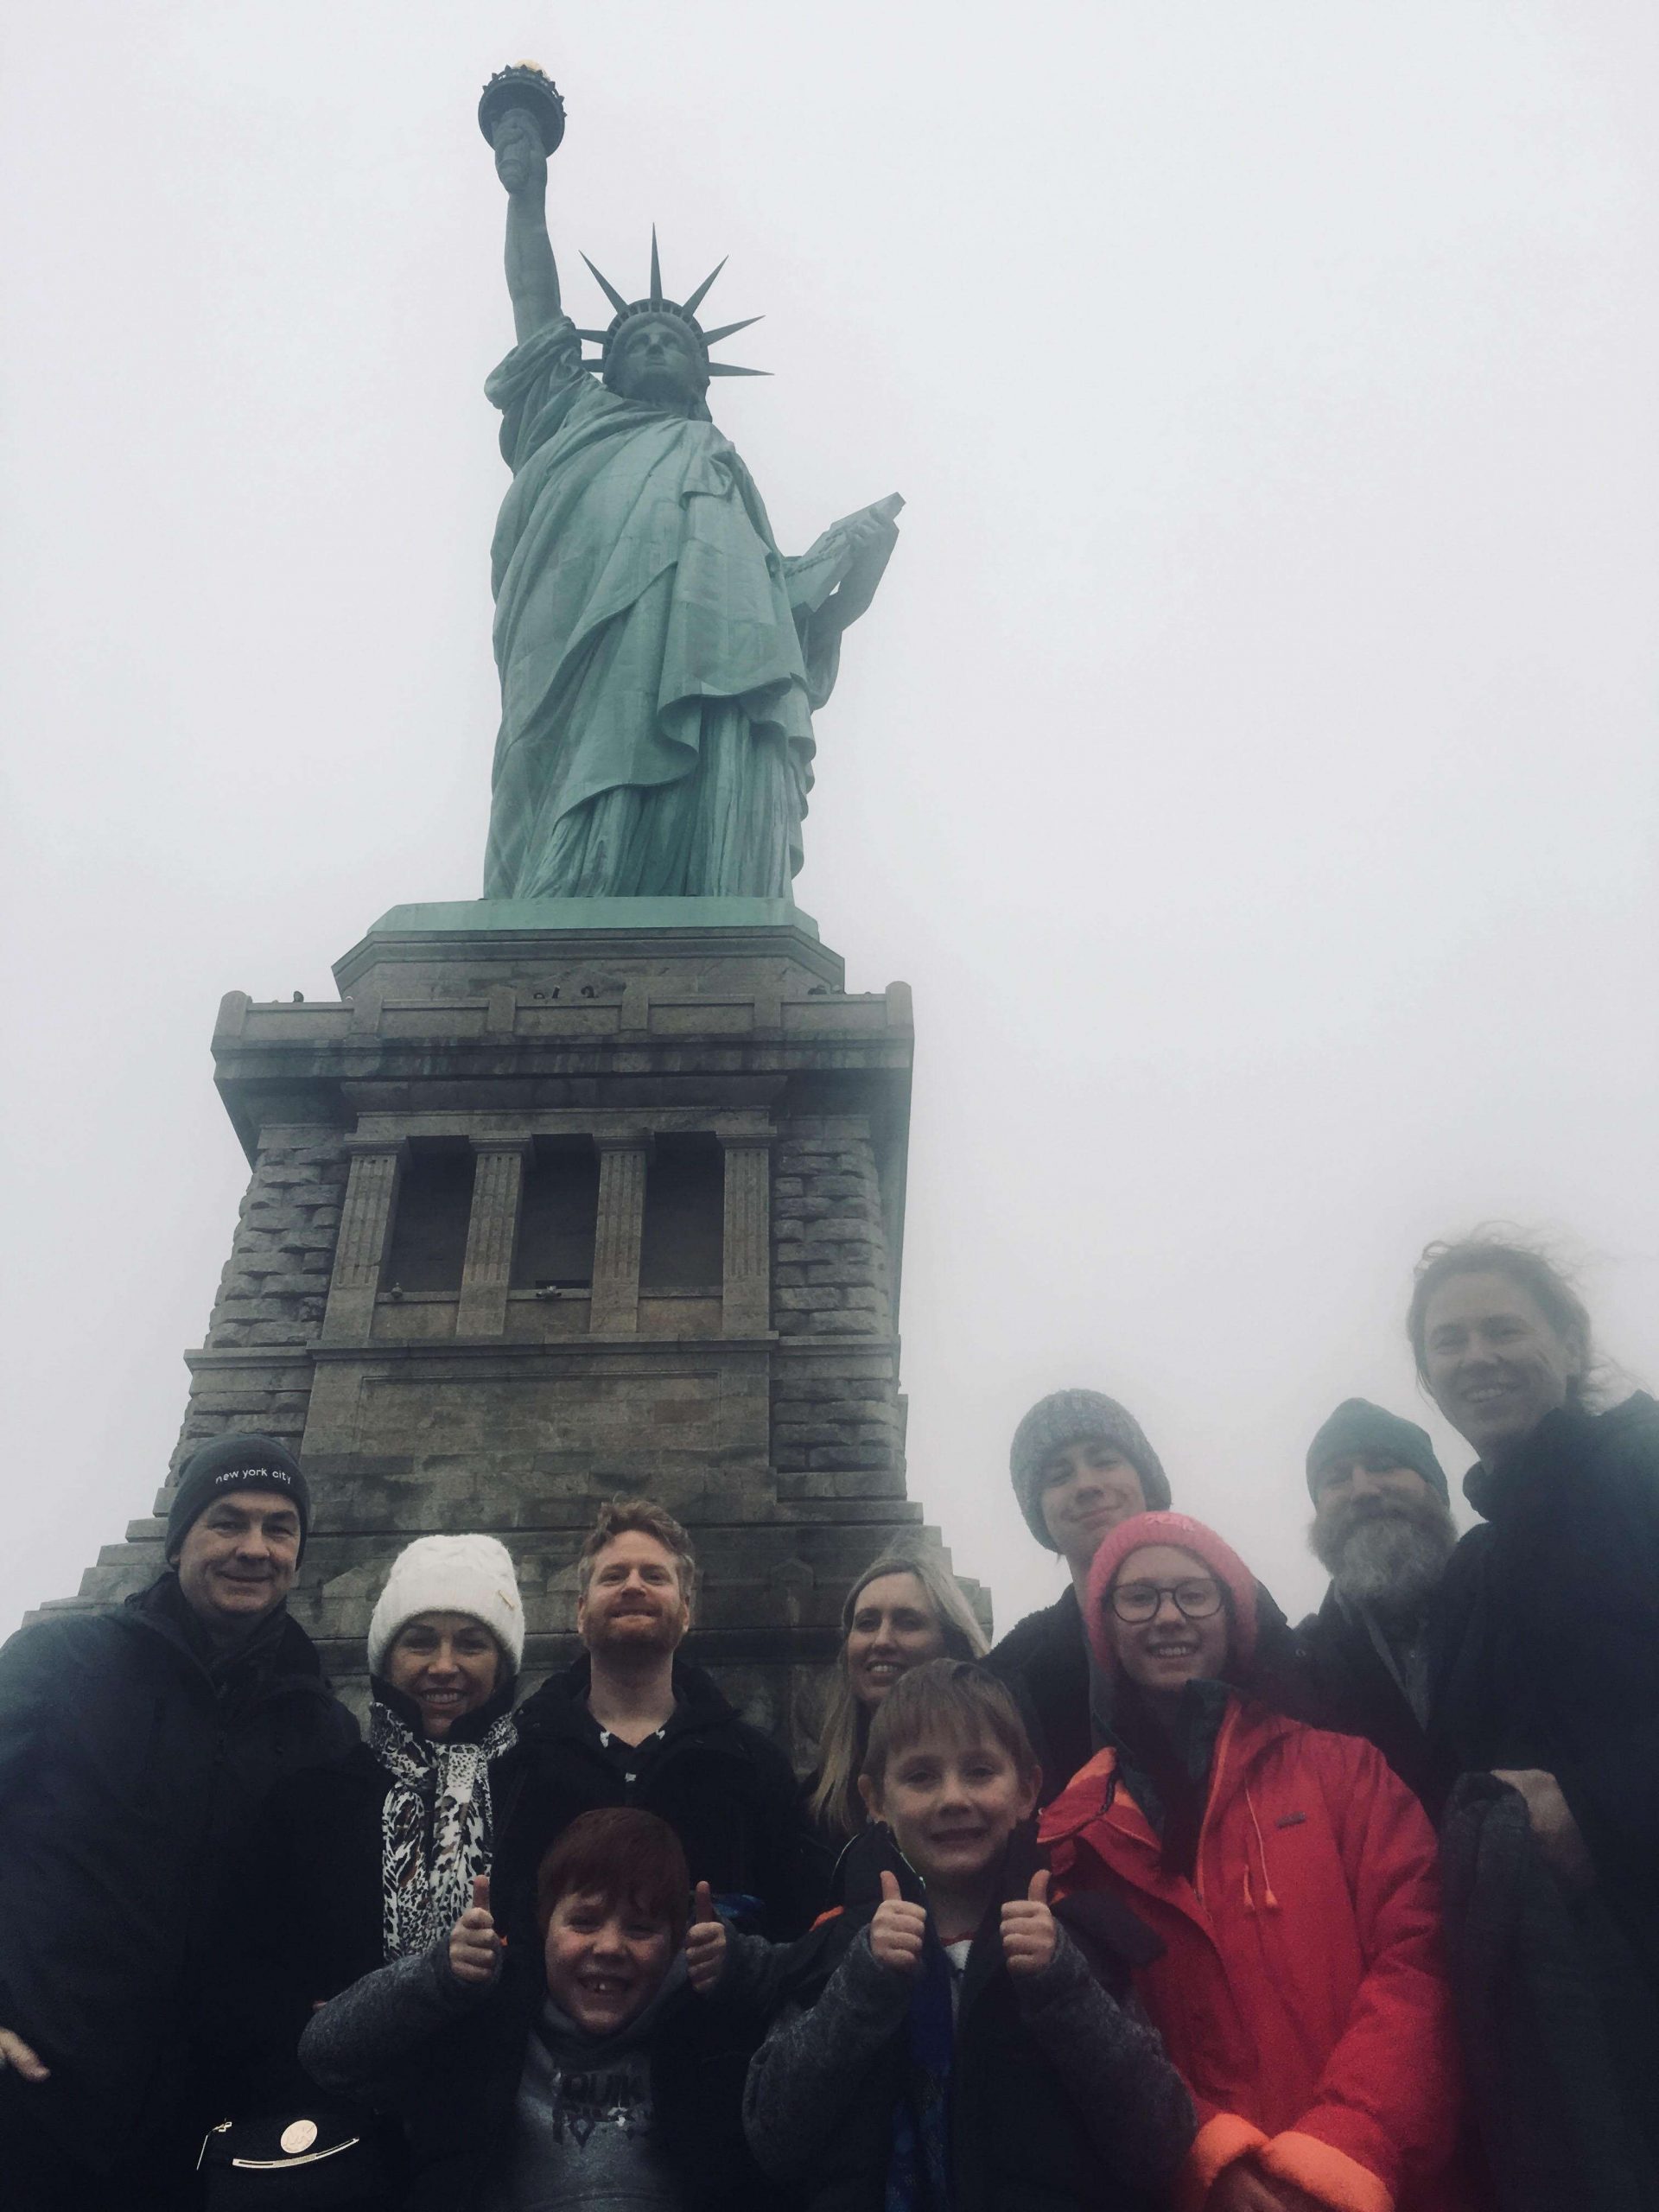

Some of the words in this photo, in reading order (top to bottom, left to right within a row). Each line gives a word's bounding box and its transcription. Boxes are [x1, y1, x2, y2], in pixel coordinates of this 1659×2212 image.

[215, 1471, 239, 1484] new
[242, 1467, 268, 1479] york
[272, 1470, 291, 1484] city
